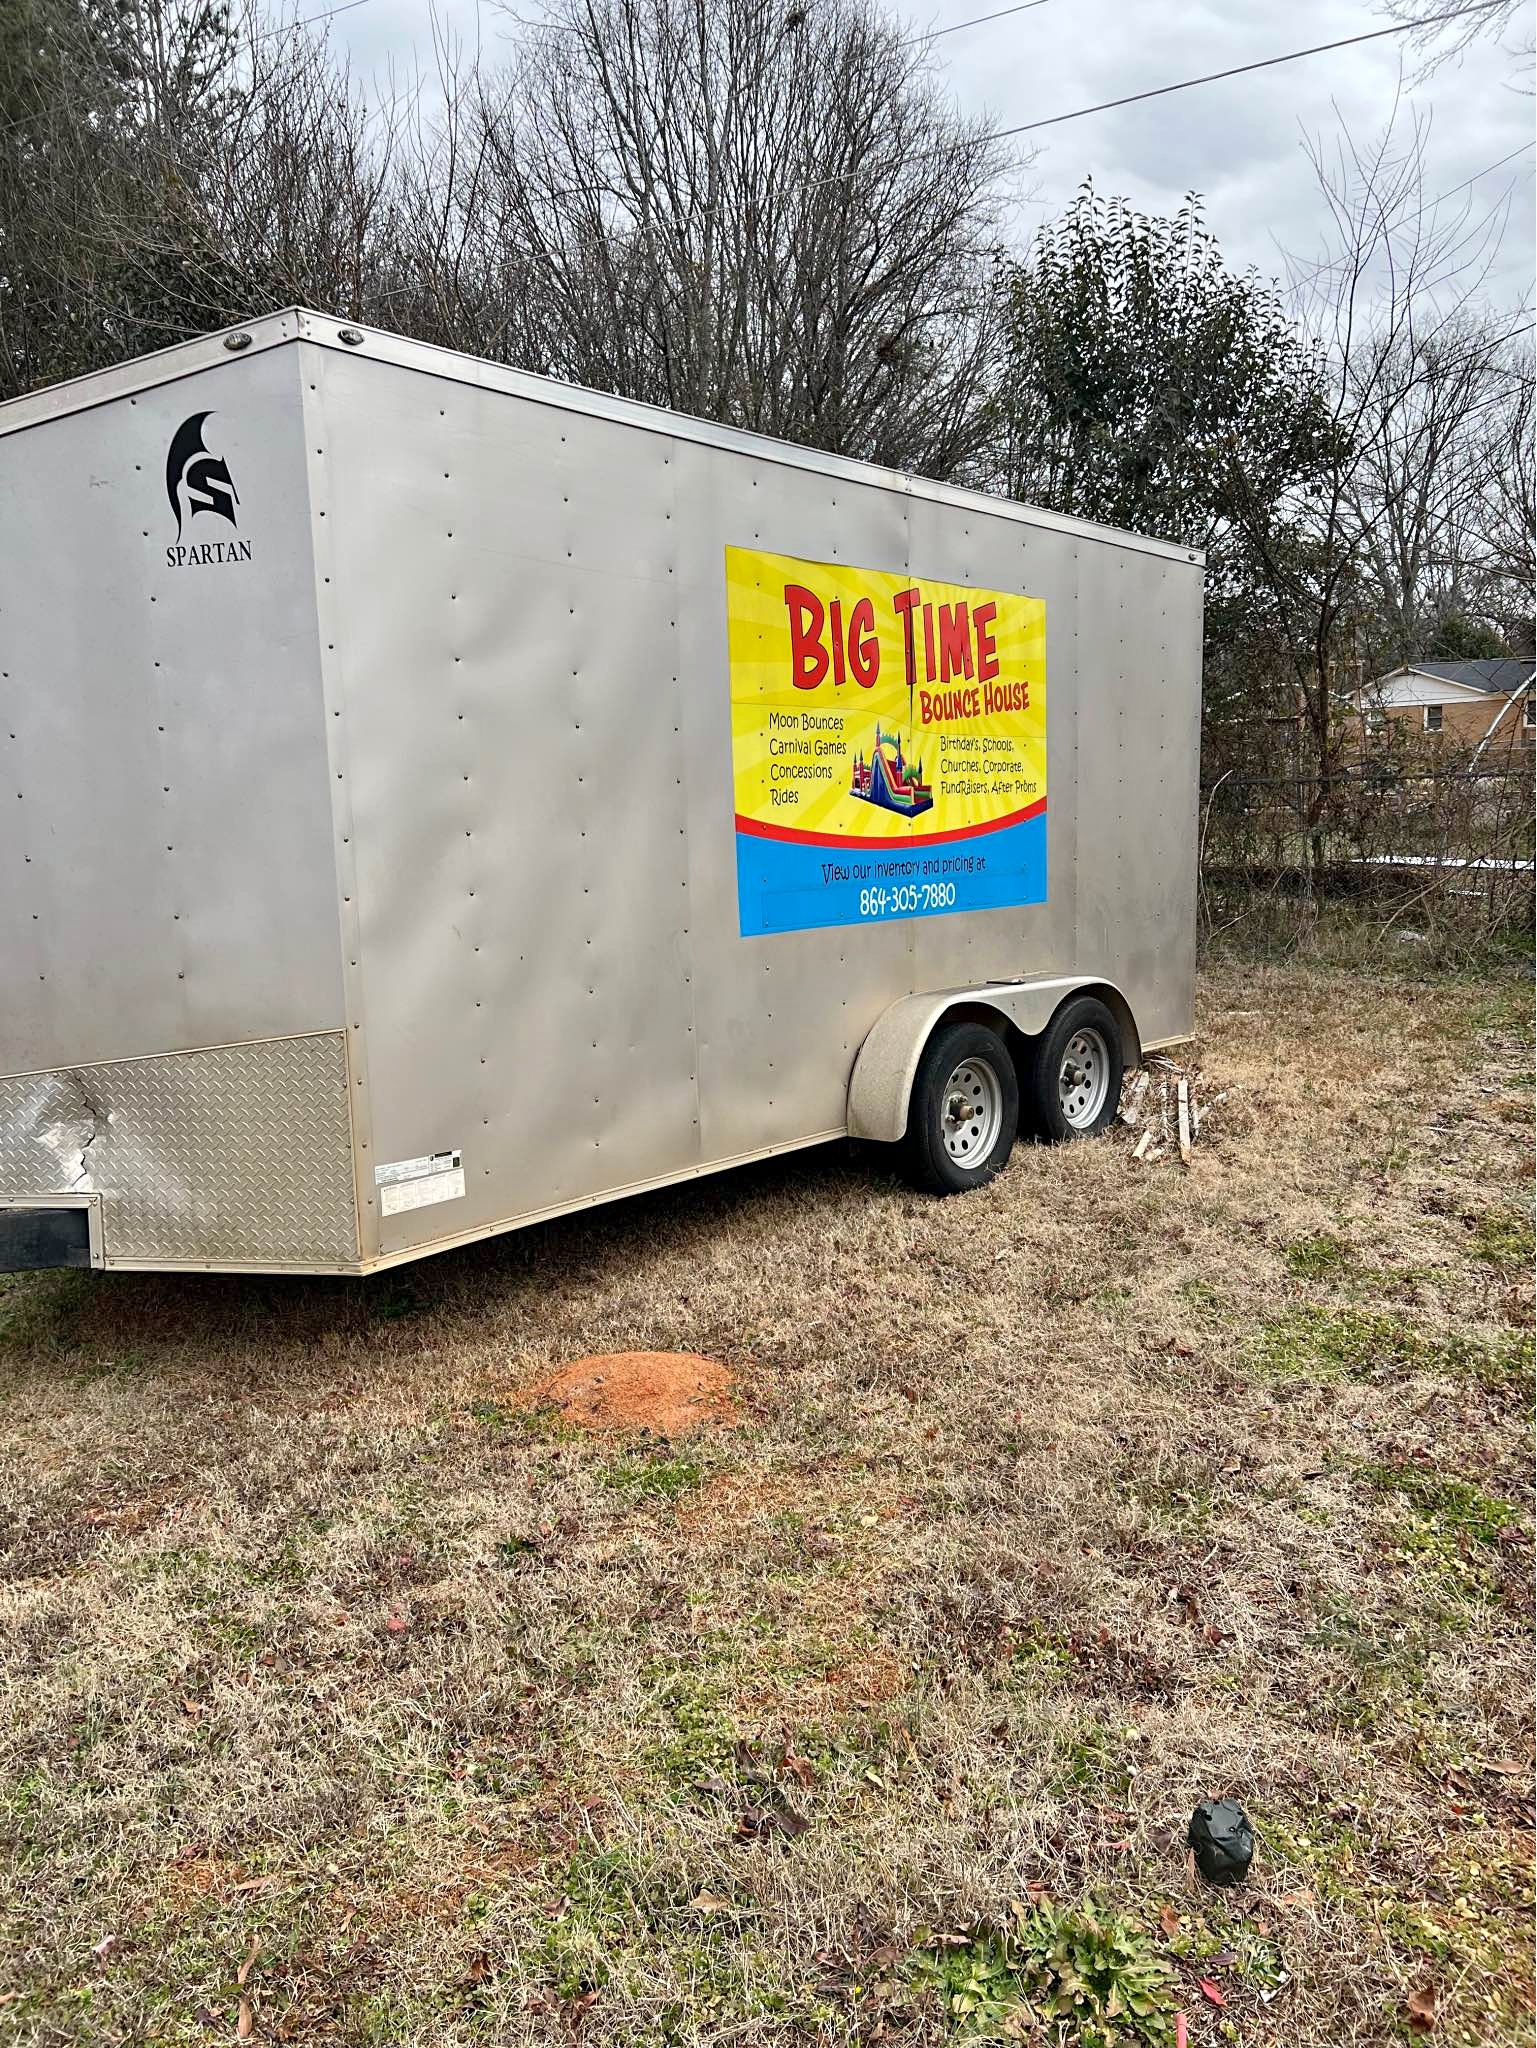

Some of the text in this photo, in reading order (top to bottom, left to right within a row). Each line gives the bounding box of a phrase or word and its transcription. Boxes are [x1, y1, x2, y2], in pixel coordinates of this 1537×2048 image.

[166, 541, 252, 567] SPARTAN
[784, 584, 999, 689] BIG TIME
[919, 681, 1030, 724] BOUNCE HOUSE
[769, 713, 844, 731] Moon Bounces
[769, 738, 847, 756] Carnival Games
[770, 763, 832, 781] Concessions
[770, 789, 799, 806] Rides
[991, 780, 1013, 794] After
[1015, 780, 1037, 794] Proms
[822, 856, 986, 885] View our inventory and pricing at
[860, 882, 956, 916] 864-305-7880
